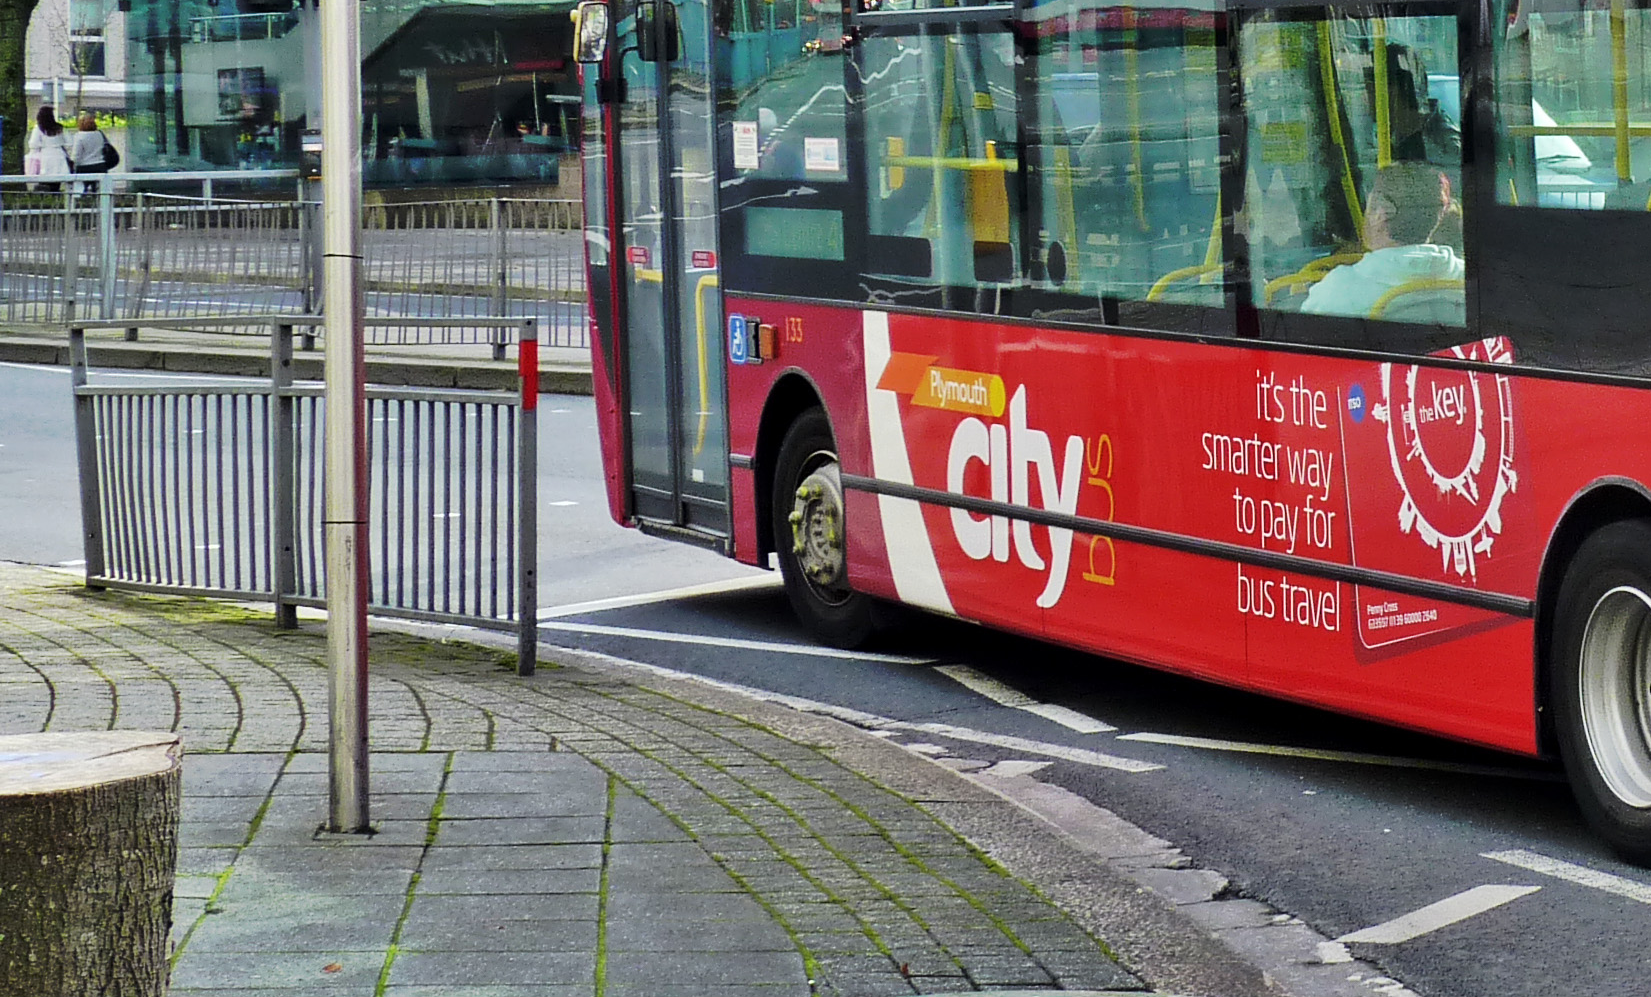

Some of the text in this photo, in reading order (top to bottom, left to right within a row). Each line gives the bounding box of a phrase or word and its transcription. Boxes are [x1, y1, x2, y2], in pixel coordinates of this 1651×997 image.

[785, 316, 803, 342] 133
[929, 369, 988, 408] Plymouth
[1256, 369, 1327, 429] it's the
[1420, 405, 1435, 424] the
[947, 383, 1084, 608] city
[1202, 432, 1333, 501] smarter way
[1083, 432, 1115, 586] bus
[1233, 488, 1335, 554] to pay for
[1237, 562, 1341, 632] bus travel
